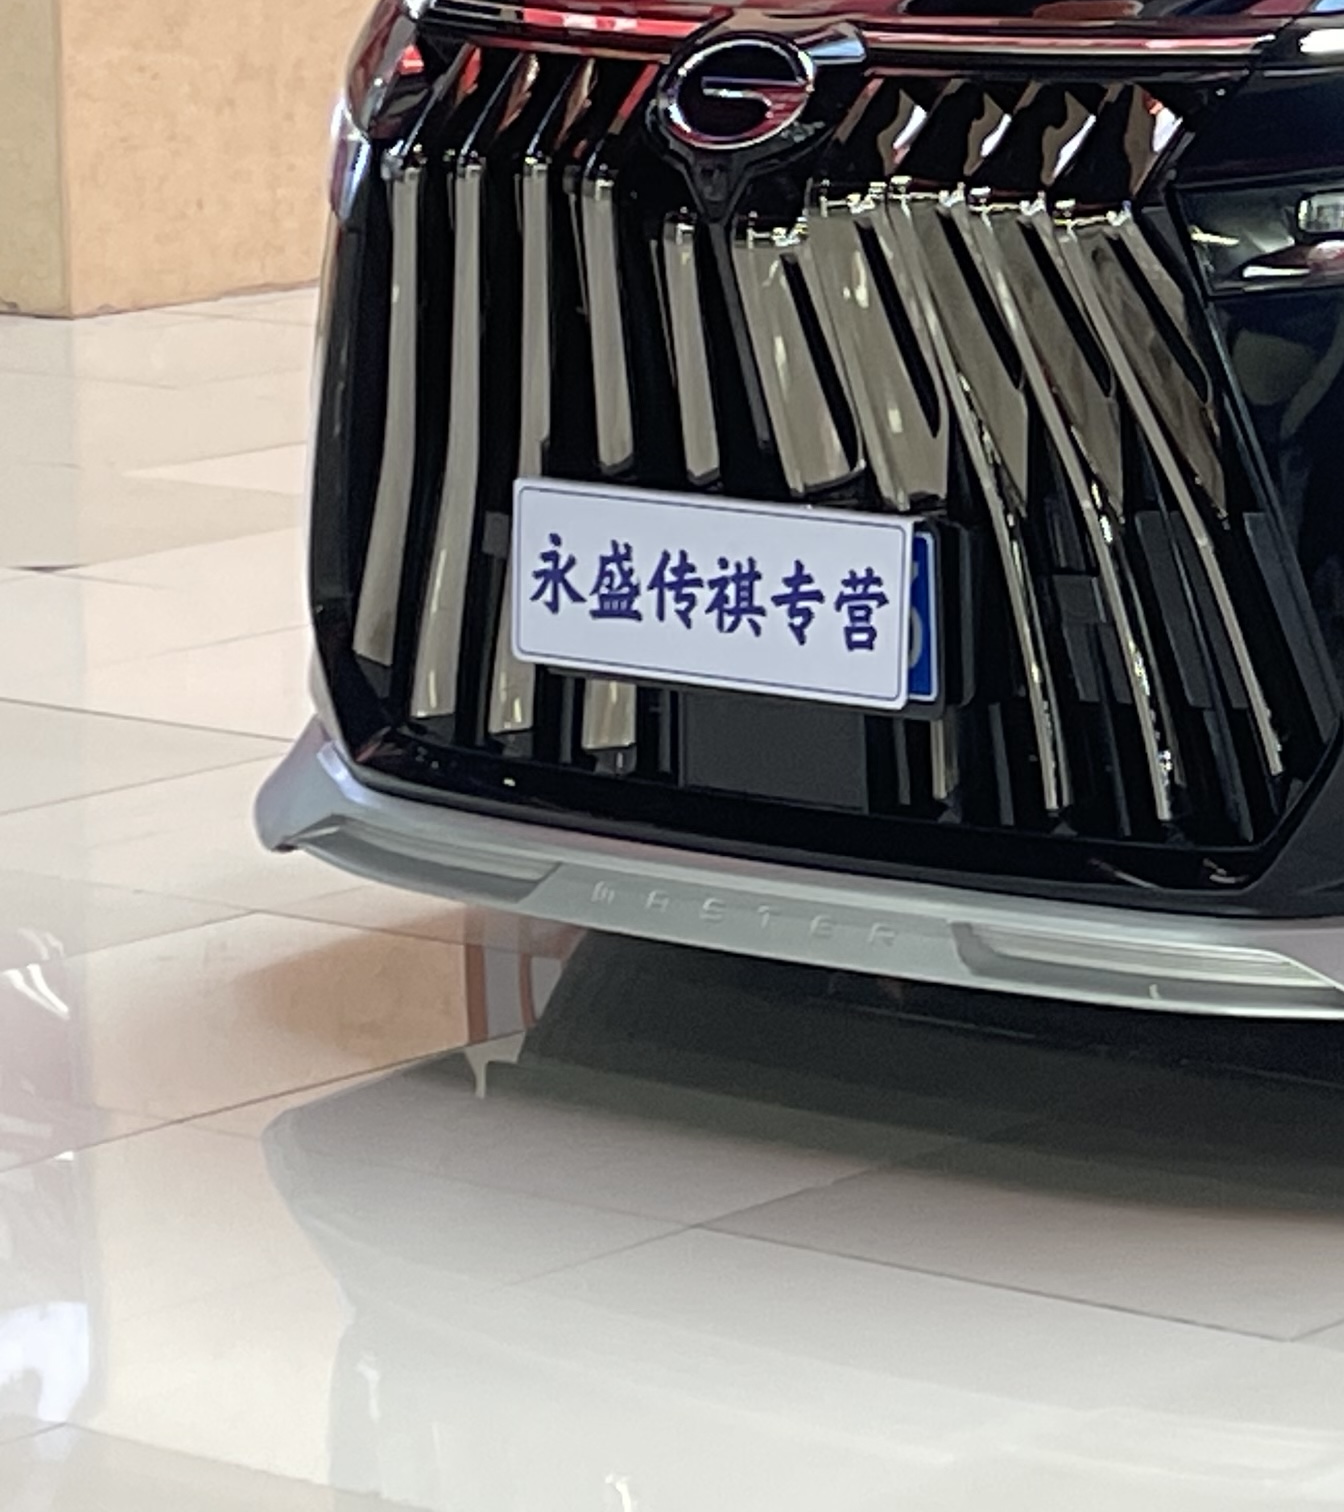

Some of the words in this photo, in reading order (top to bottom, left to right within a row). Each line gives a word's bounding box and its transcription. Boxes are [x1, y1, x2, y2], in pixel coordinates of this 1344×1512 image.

[529, 532, 890, 653] 永盛传祺专营
